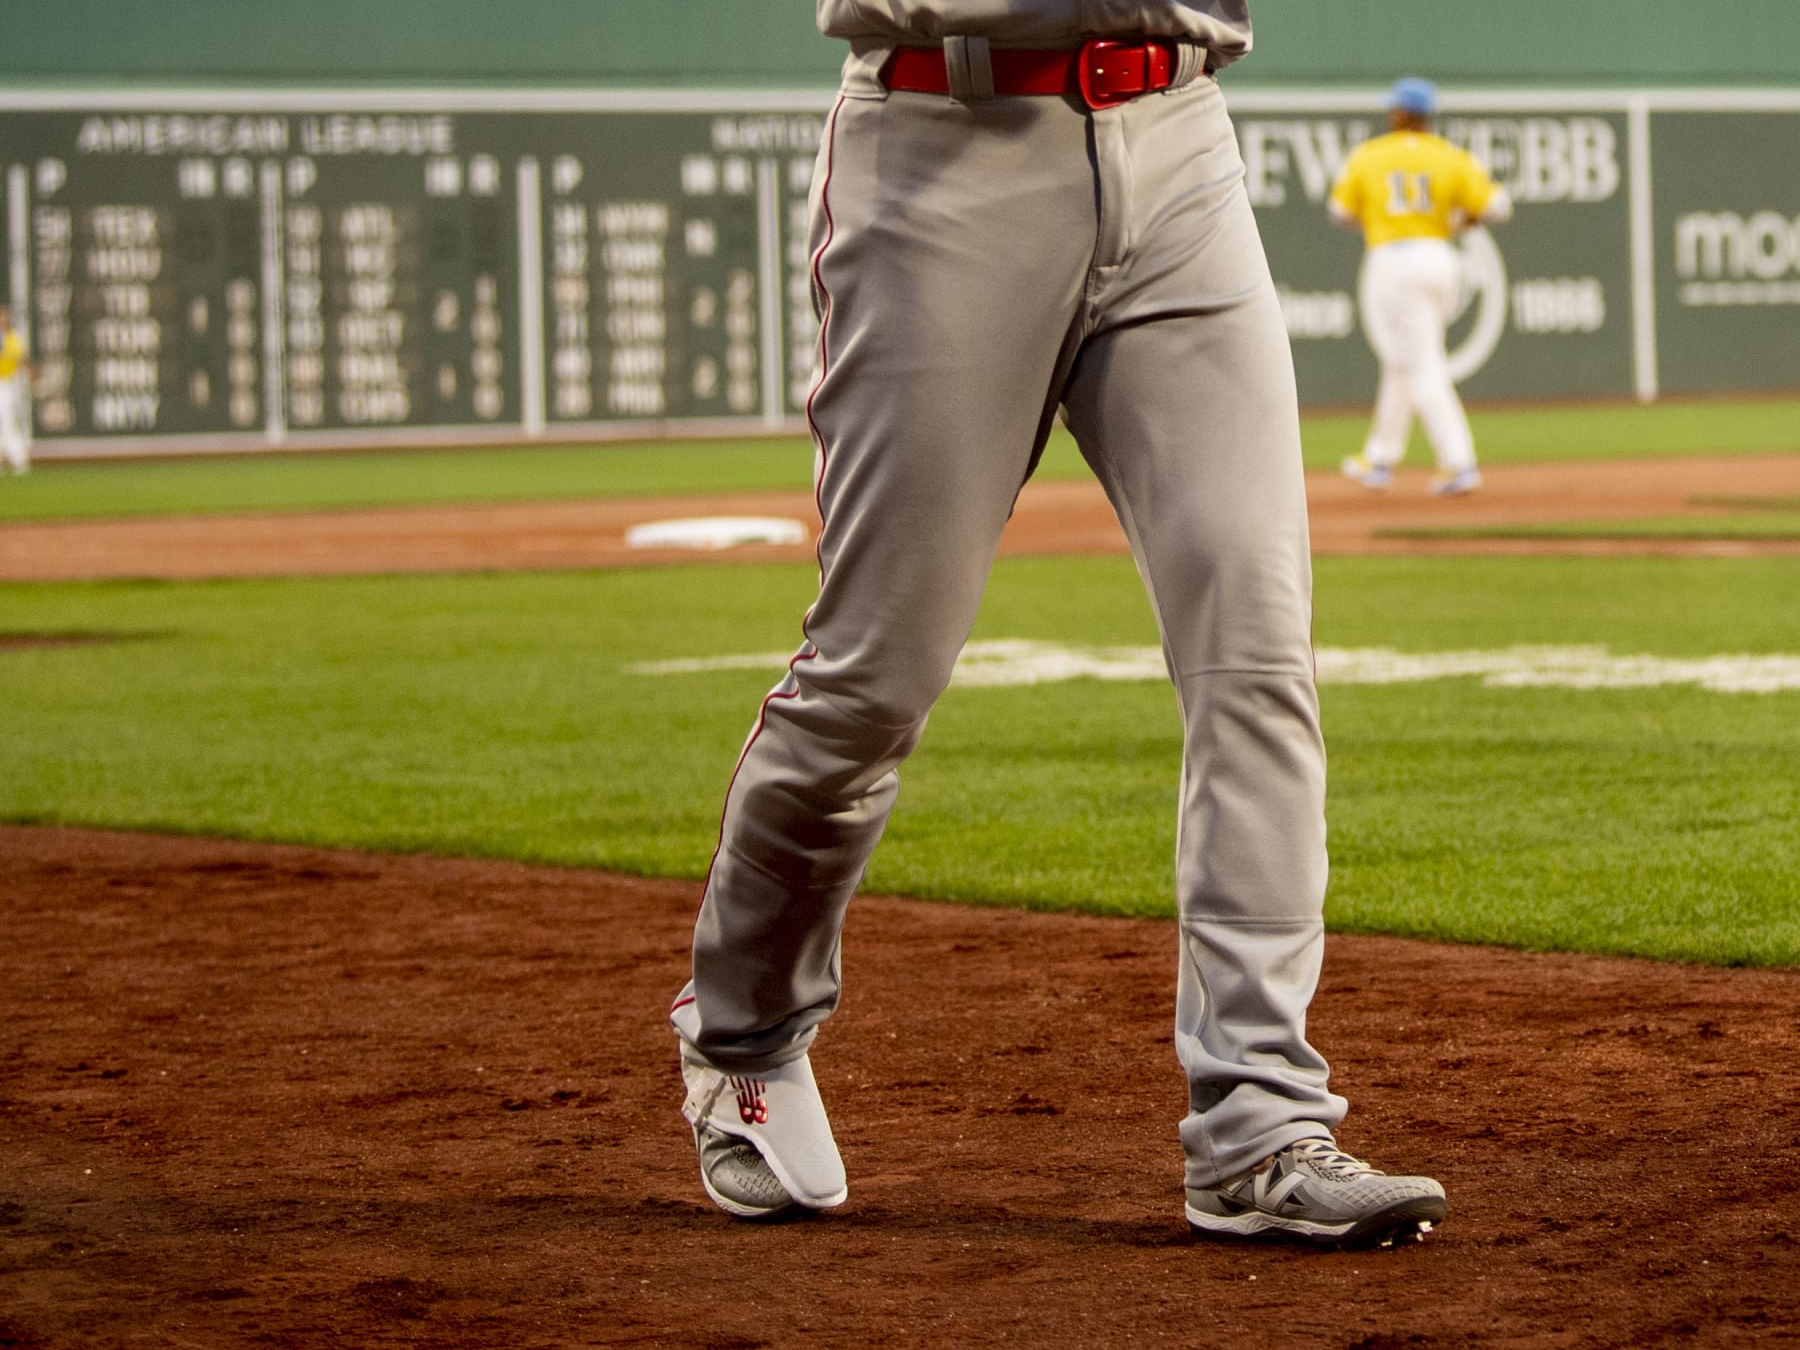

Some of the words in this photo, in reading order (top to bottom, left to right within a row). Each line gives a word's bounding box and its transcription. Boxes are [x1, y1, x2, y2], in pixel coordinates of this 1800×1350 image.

[1385, 169, 1435, 216] 11
[1448, 117, 1621, 202] EBB
[1675, 211, 1800, 278] mo
